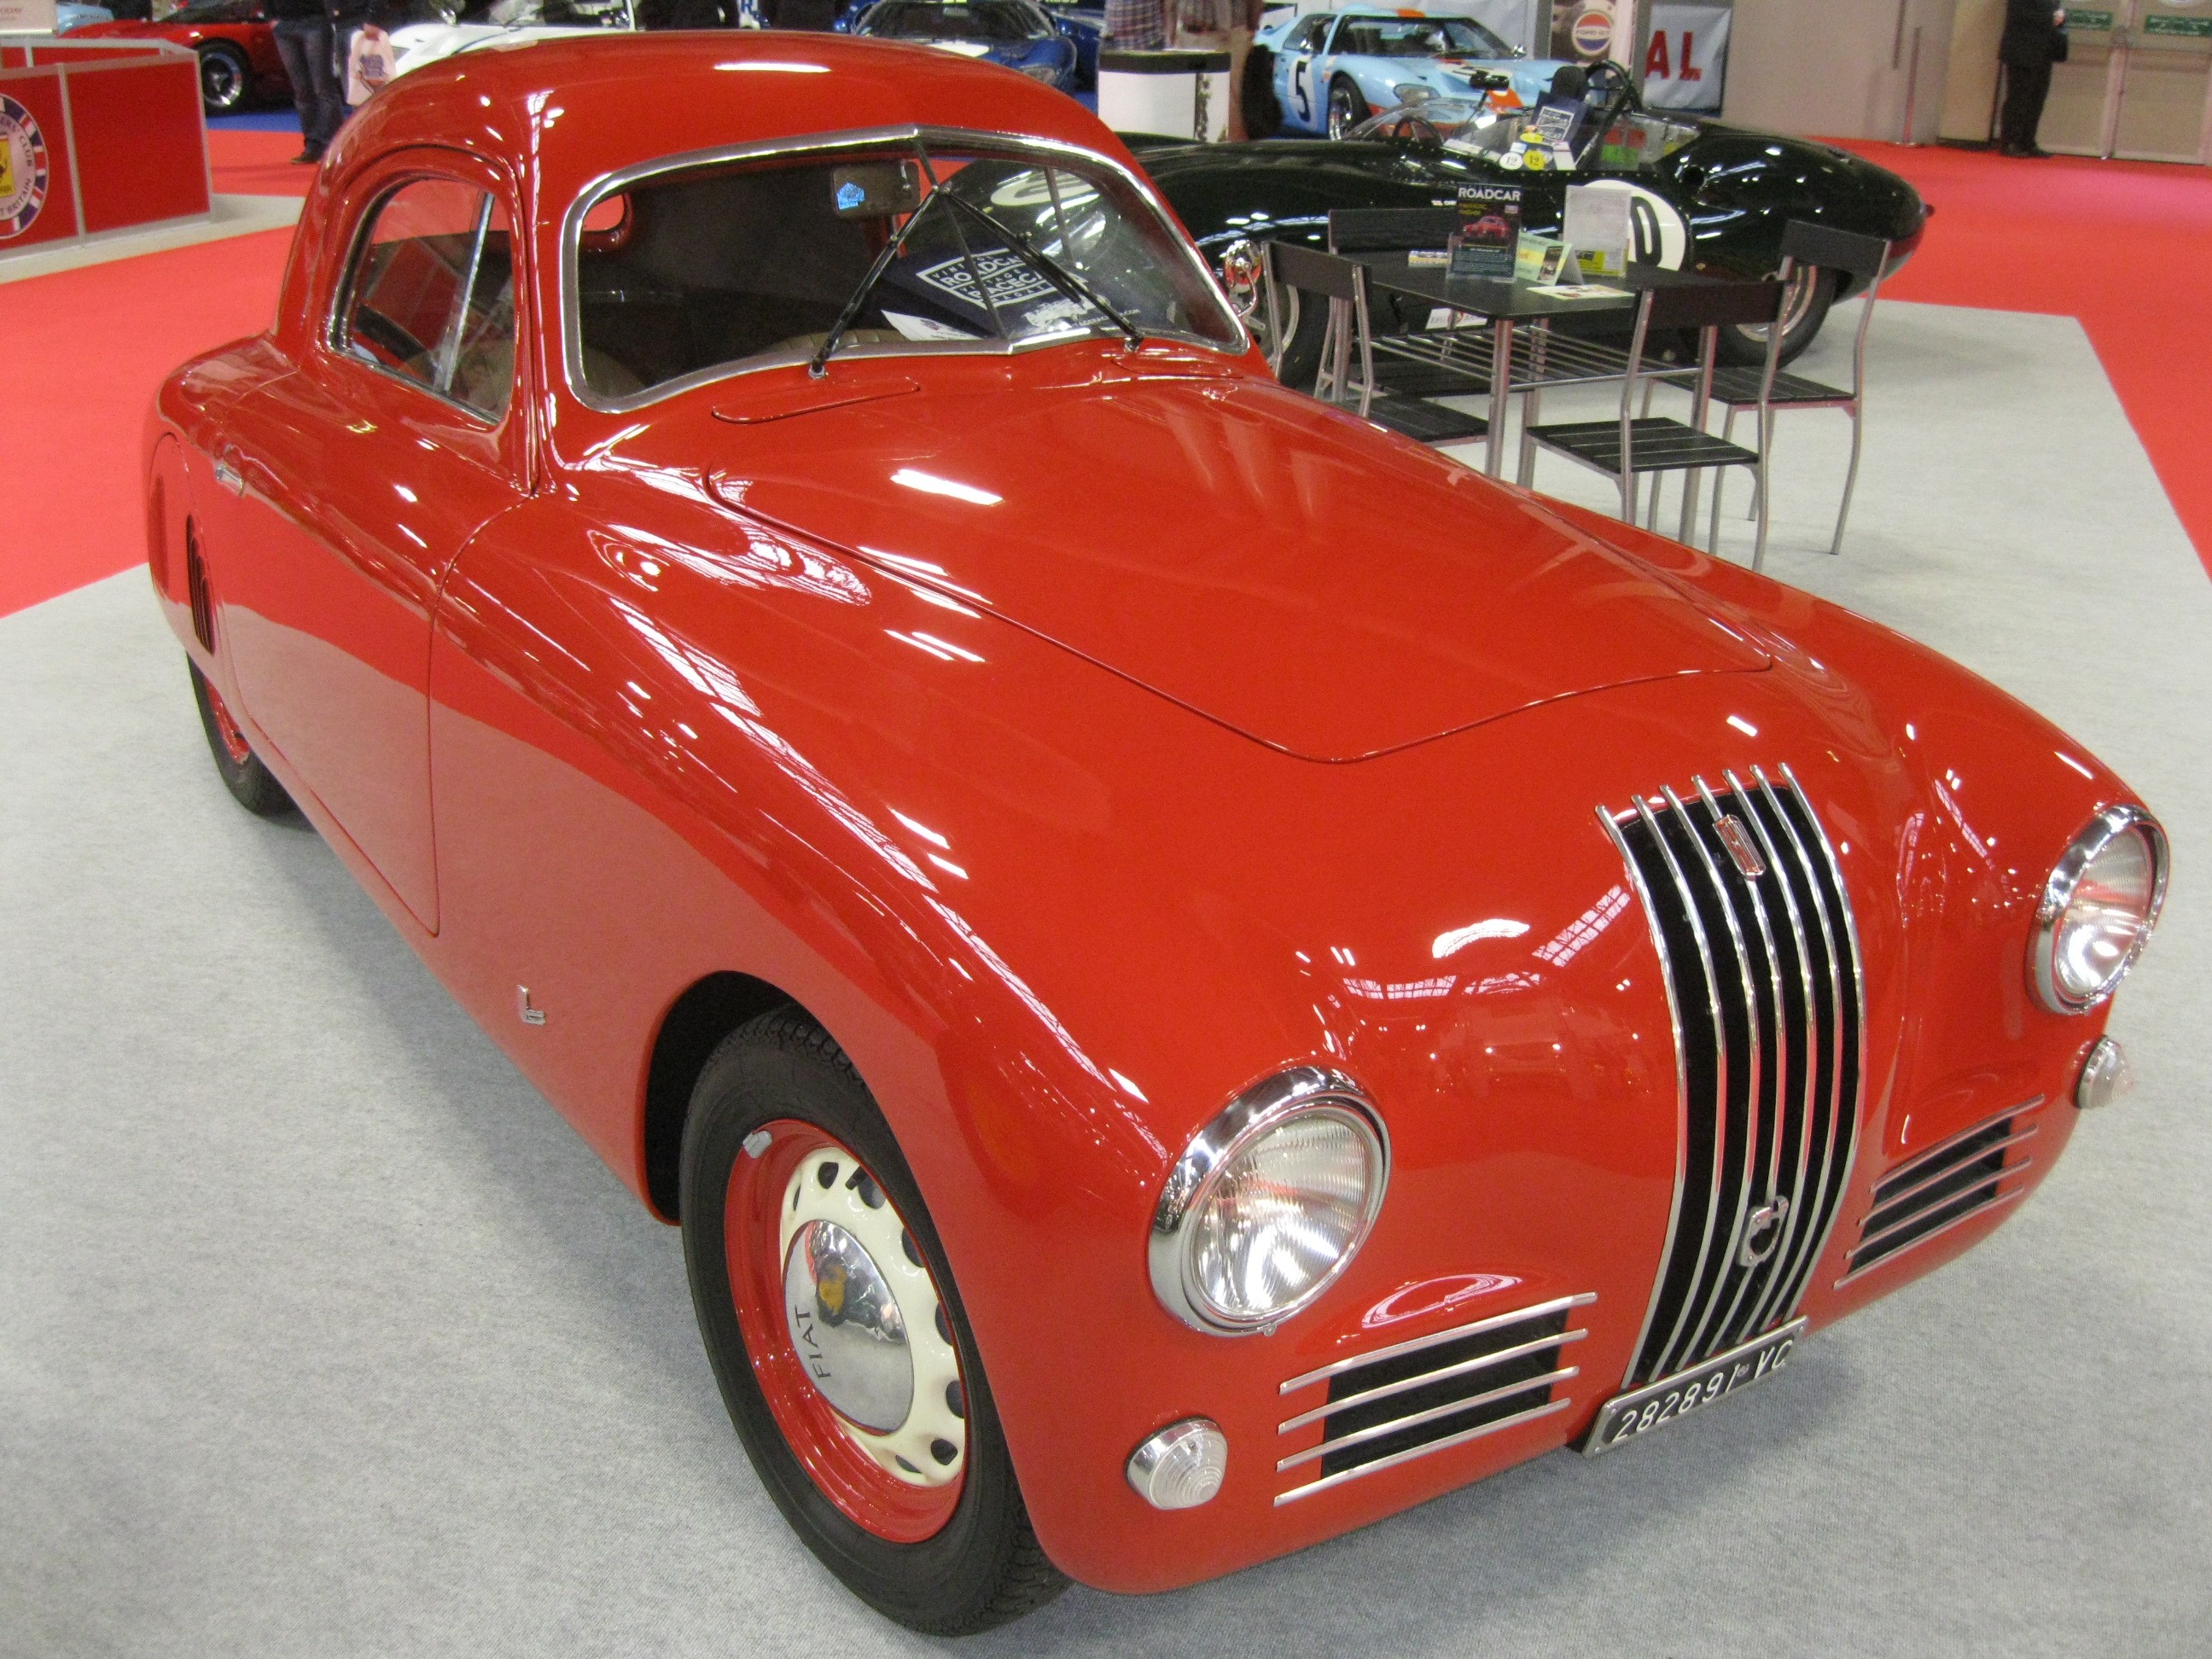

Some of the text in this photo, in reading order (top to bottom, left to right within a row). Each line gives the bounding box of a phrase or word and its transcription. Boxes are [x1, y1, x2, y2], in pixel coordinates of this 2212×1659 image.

[1295, 61, 1311, 122] 5
[1458, 187, 1521, 201] ROADCAR
[795, 1305, 831, 1378] FIAT
[1611, 1340, 1793, 1443] 282891 VC
